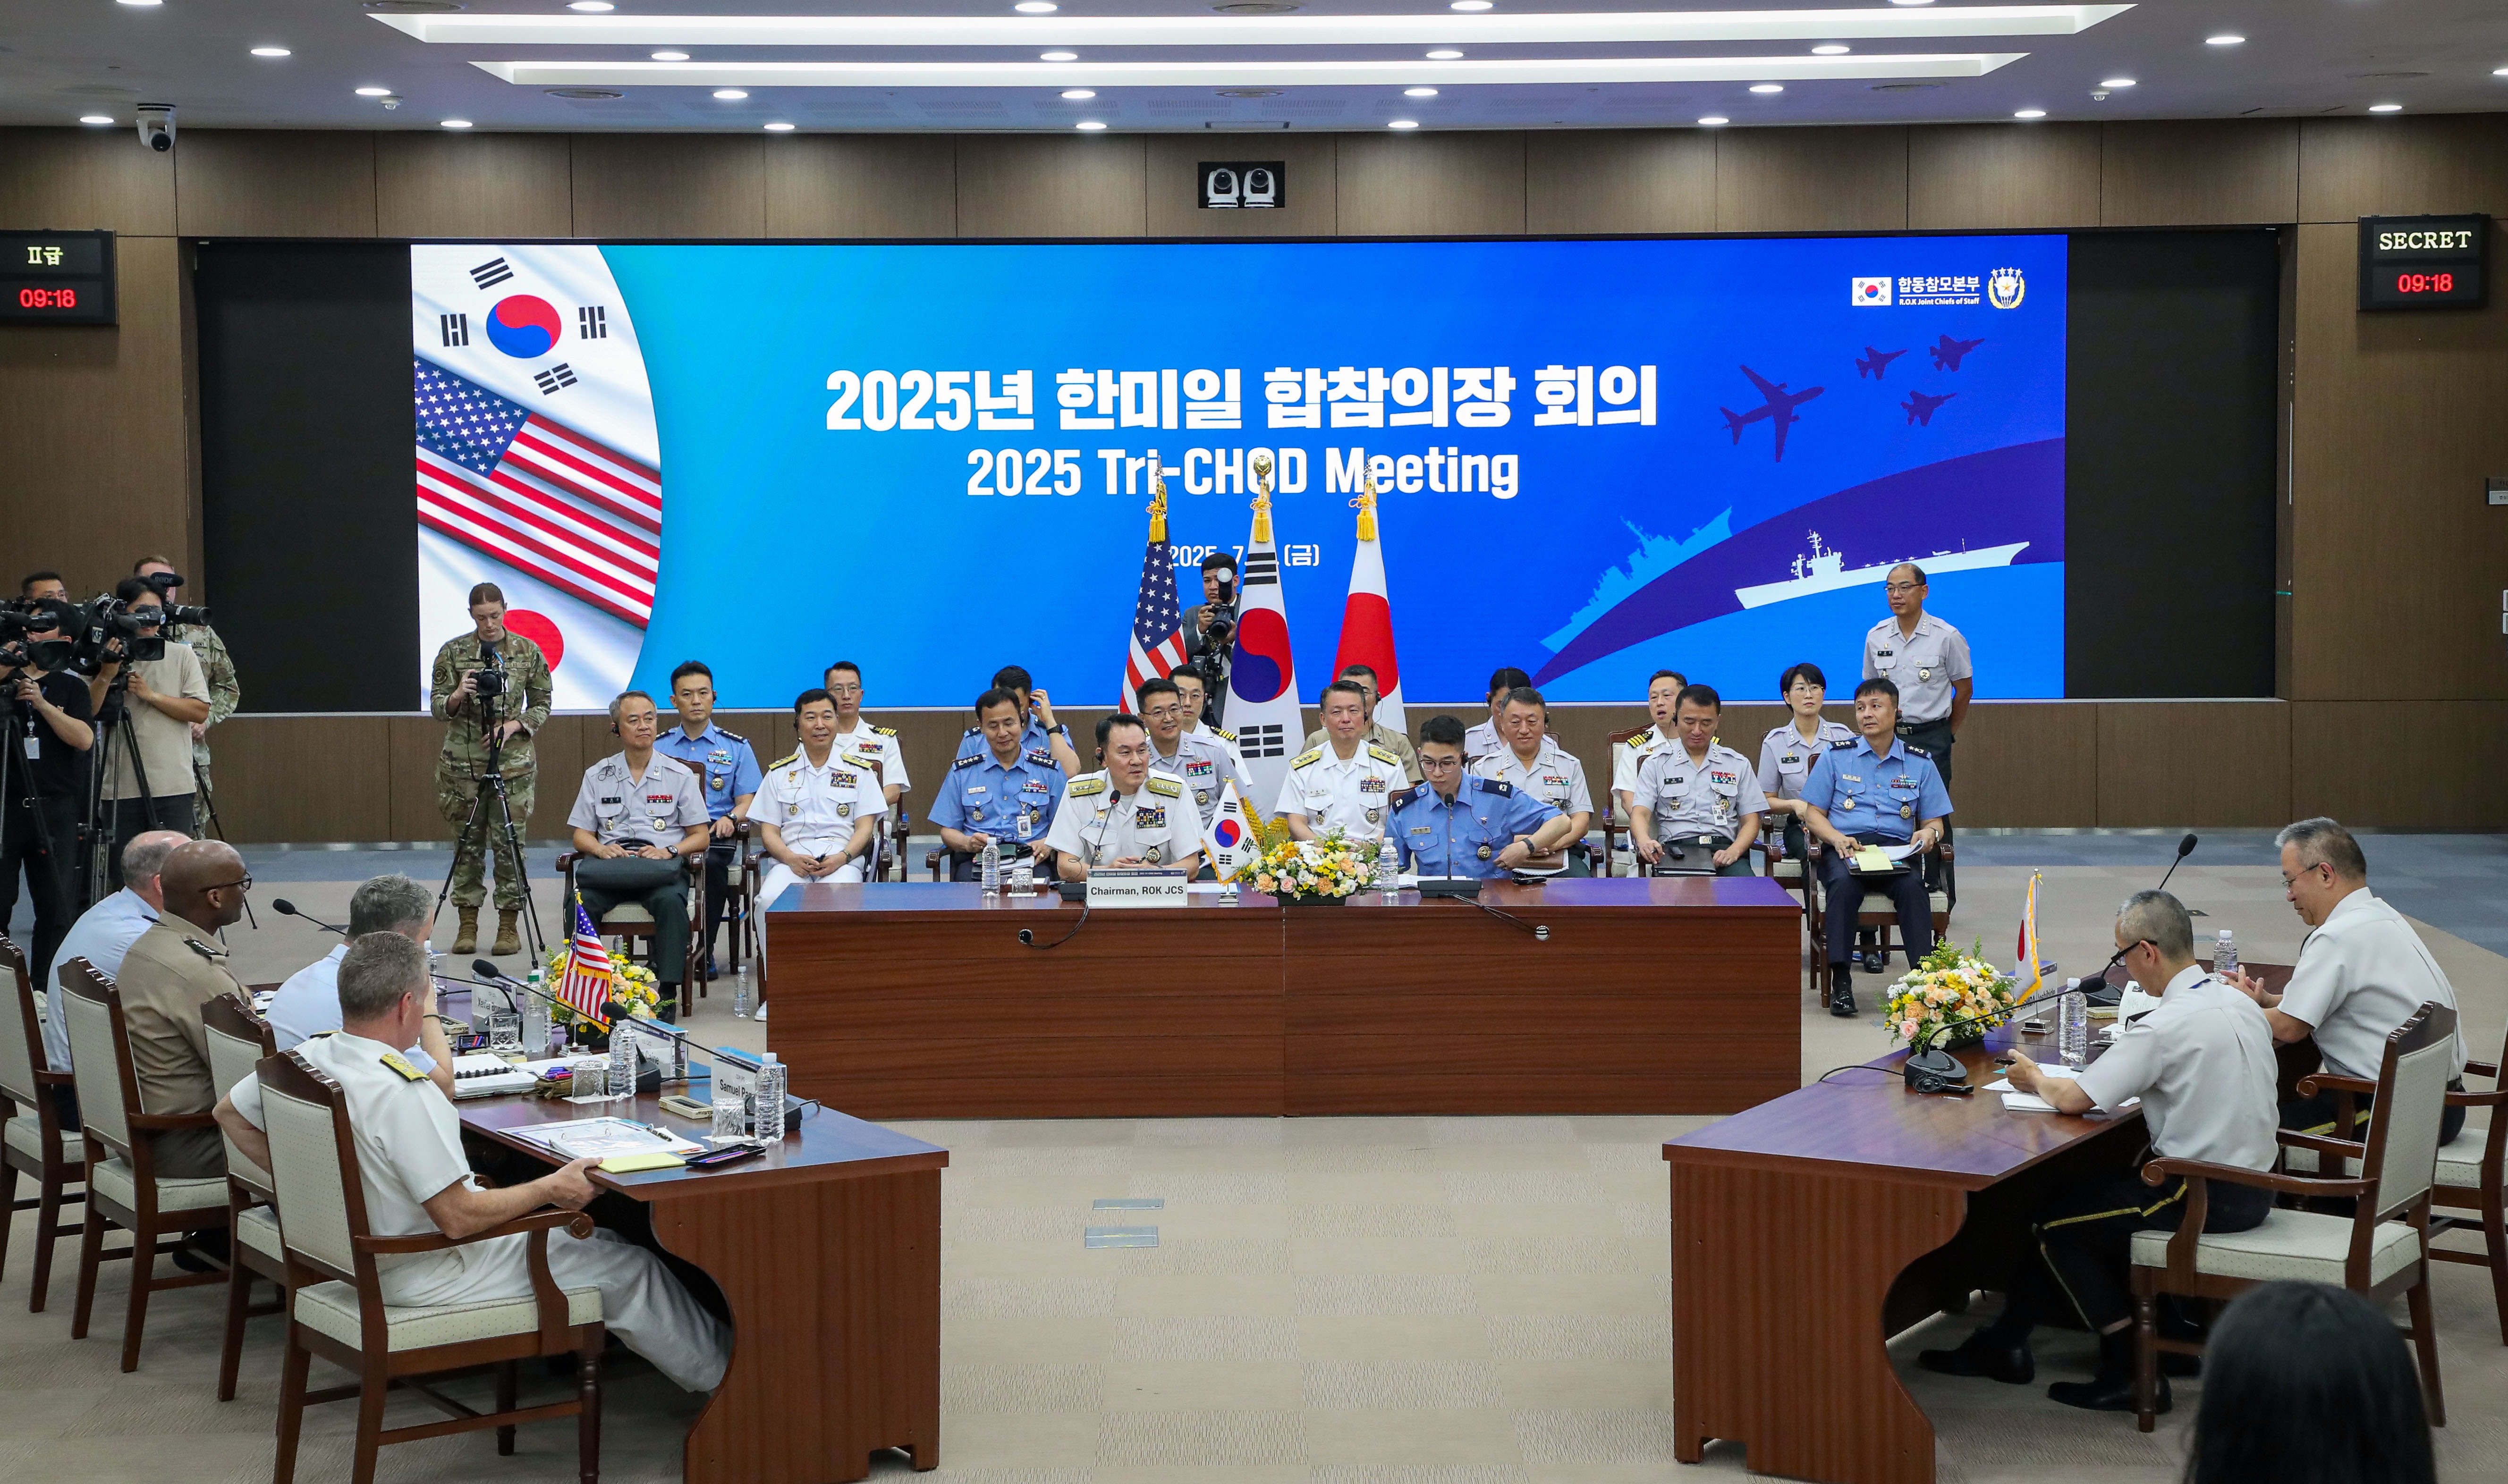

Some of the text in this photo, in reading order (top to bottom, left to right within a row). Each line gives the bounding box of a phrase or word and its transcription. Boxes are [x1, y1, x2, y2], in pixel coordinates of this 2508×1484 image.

[2379, 231, 2472, 250] SECRET
[1898, 276, 1980, 293] 합동참모본부
[2398, 273, 2453, 293] 09:18
[19, 288, 76, 308] 09:18
[826, 364, 1657, 431] 2025년 한미일 합참의장 회의
[967, 447, 1519, 499] 2025 Tri-CHOD Meeting
[1284, 544, 1320, 567] (금)
[1091, 886, 1184, 896] Chairman, ROK JCS
[720, 1079, 740, 1097] Samuel
